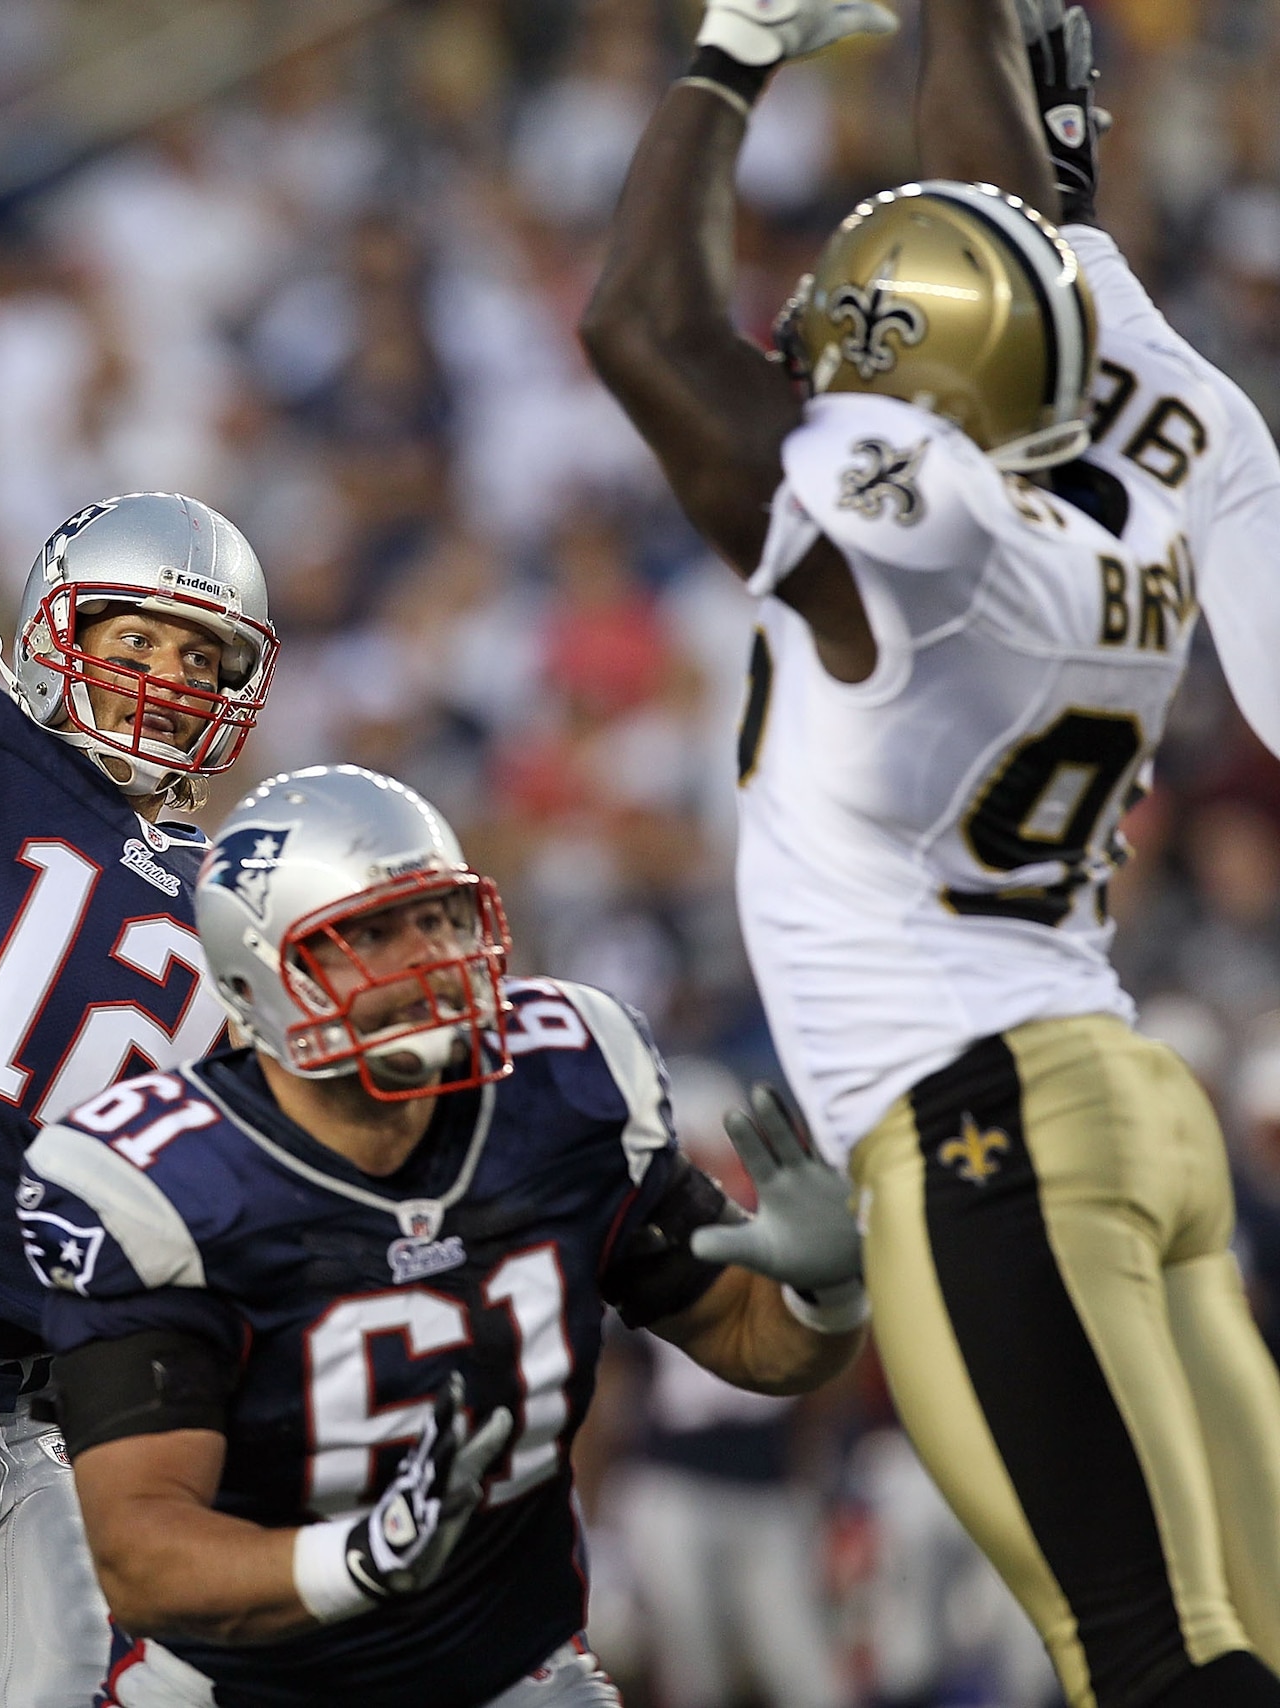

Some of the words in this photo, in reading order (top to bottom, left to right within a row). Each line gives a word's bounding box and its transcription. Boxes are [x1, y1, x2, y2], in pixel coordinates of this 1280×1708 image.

[176, 573, 221, 596] Riddell
[119, 838, 181, 897] Patriots
[937, 704, 1155, 928] 9
[69, 1065, 222, 1170] 61
[302, 1238, 575, 1516] 61
